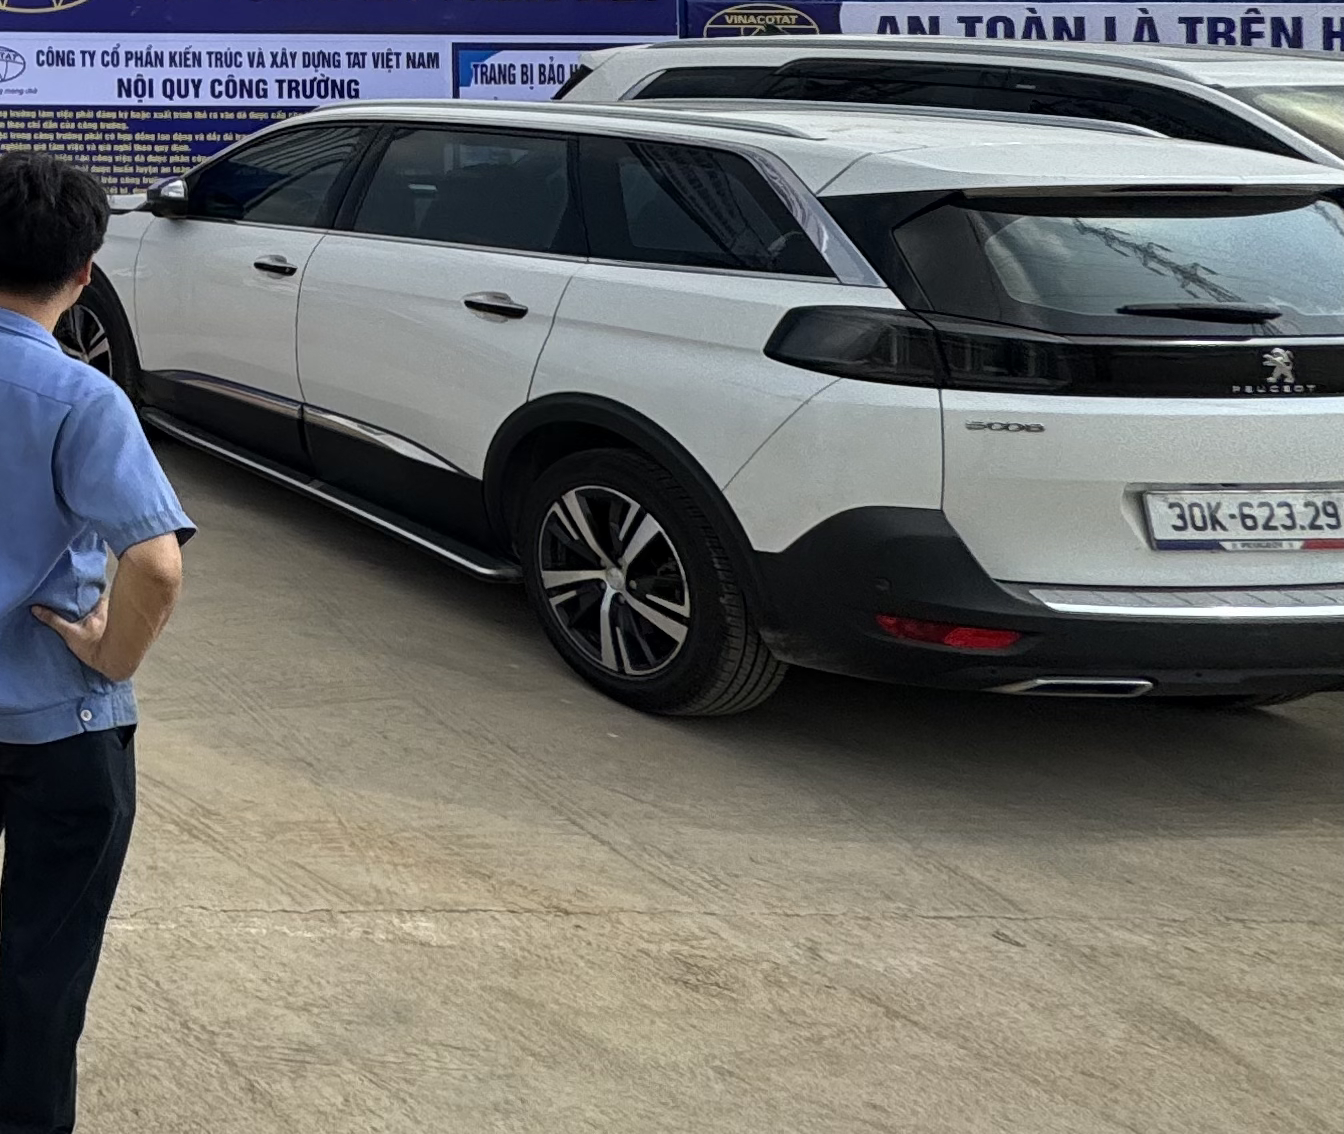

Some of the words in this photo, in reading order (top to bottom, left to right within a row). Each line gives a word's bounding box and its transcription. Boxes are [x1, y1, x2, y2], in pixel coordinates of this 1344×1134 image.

[724, 14, 799, 25] VINACOTAT
[956, 7, 1085, 41] TOÀN
[1178, 8, 1303, 47] TRÊN
[36, 46, 75, 67] CÔNG
[80, 50, 96, 67] TY
[101, 43, 120, 67] CỔ
[125, 43, 164, 68] PHẦN
[169, 43, 202, 68] KIẾN
[207, 47, 243, 68] TRÚC
[247, 47, 265, 68] VÀ
[270, 47, 297, 68] XÂY
[302, 49, 341, 73] DỰNG
[346, 52, 367, 69] TAT
[372, 48, 401, 74] VIỆT
[407, 52, 439, 69] NAM
[472, 63, 516, 86] TRANG
[520, 64, 534, 90] BỊ
[538, 56, 565, 85] BẢO
[117, 74, 154, 103] NỘI
[162, 78, 202, 99] QUY
[210, 73, 268, 99] CÔNG
[275, 75, 360, 99] TRƯỜNG
[965, 422, 1045, 433] 5008
[1168, 501, 1342, 532] 30K-623.29
